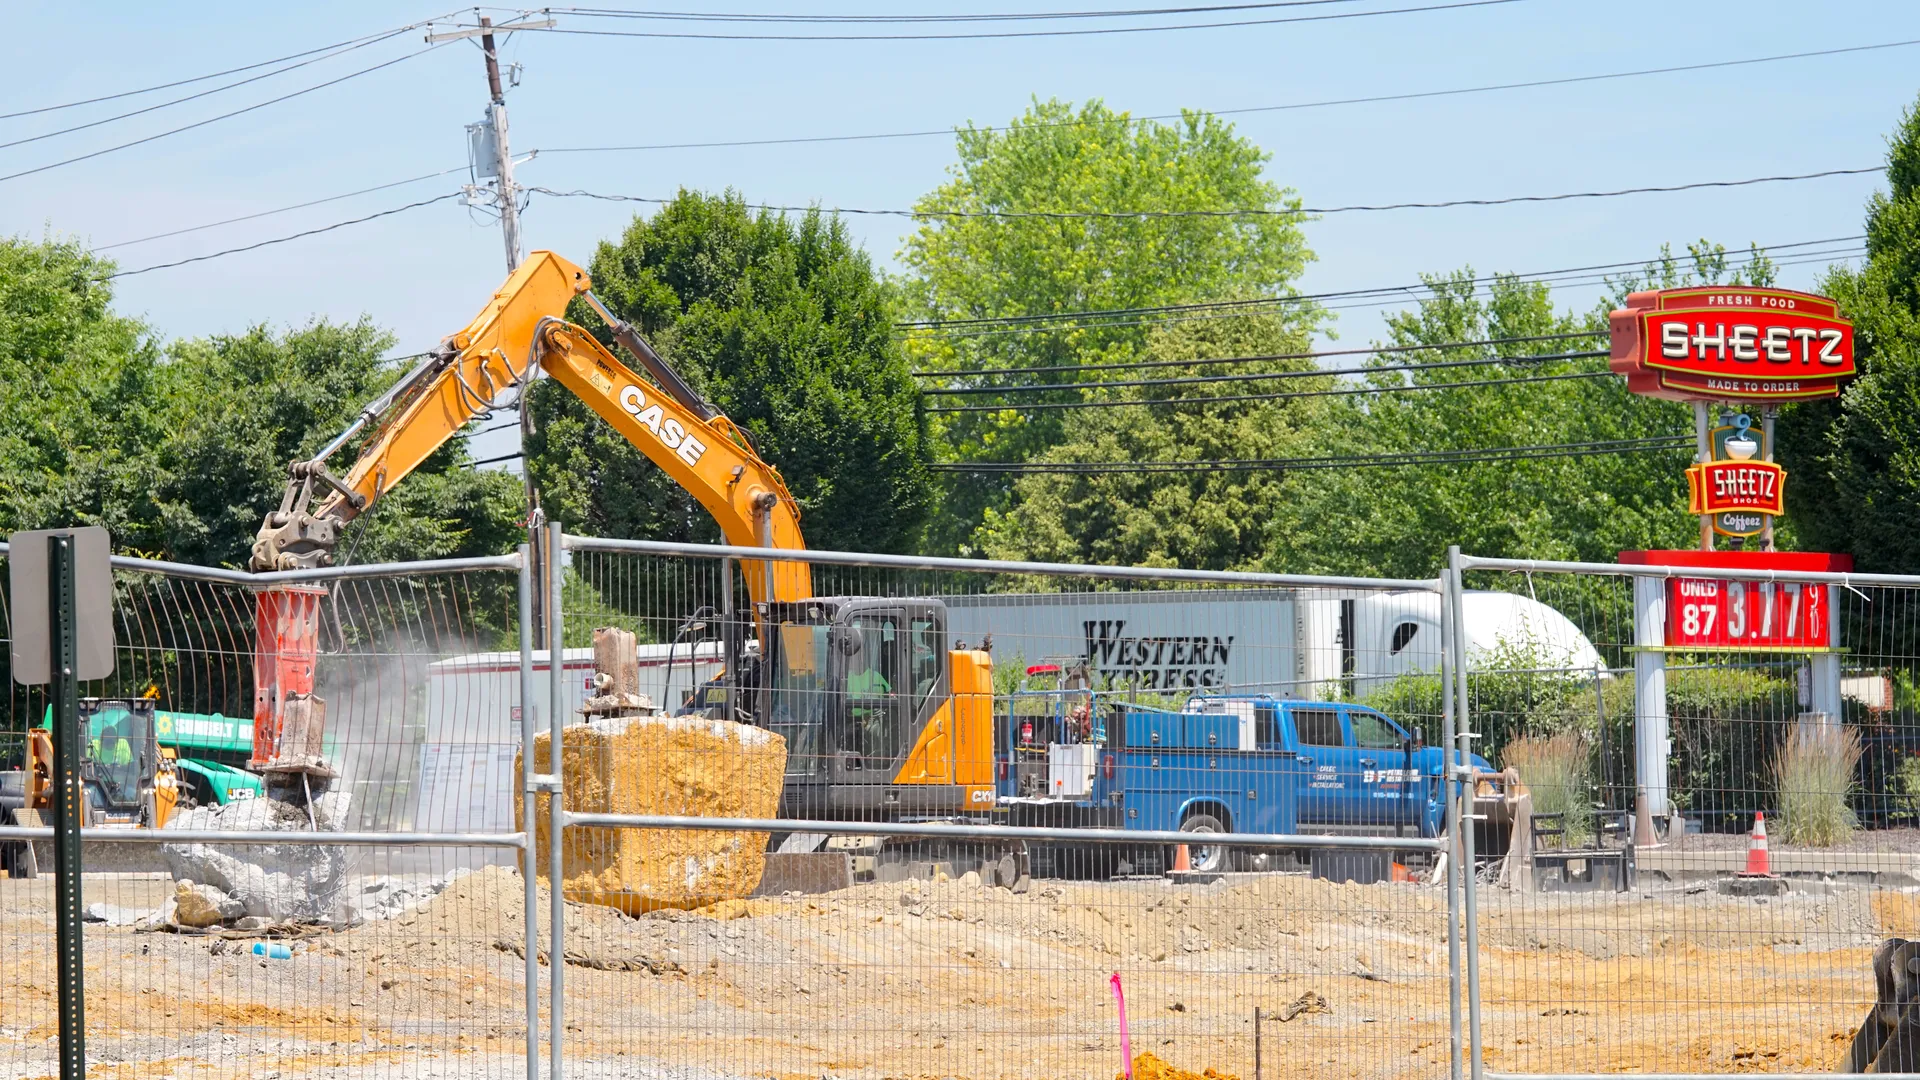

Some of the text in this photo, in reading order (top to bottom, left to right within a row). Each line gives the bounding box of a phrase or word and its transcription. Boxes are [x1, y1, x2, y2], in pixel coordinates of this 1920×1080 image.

[1708, 295, 1795, 309] FRESH FOOD
[1661, 322, 1843, 365] SHEETZ
[1707, 379, 1800, 392] MADE TO ORDER
[619, 384, 707, 467] CASE
[1714, 468, 1775, 498] SHEETZ
[1723, 513, 1761, 531] Coffeez
[1680, 582, 1718, 597] UNLD
[1682, 604, 1718, 636] 87
[1082, 620, 1235, 666] WESTERN
[1096, 668, 1216, 696] XPRESS
[175, 718, 234, 738] SUNBELT
[228, 787, 255, 801] JCB
